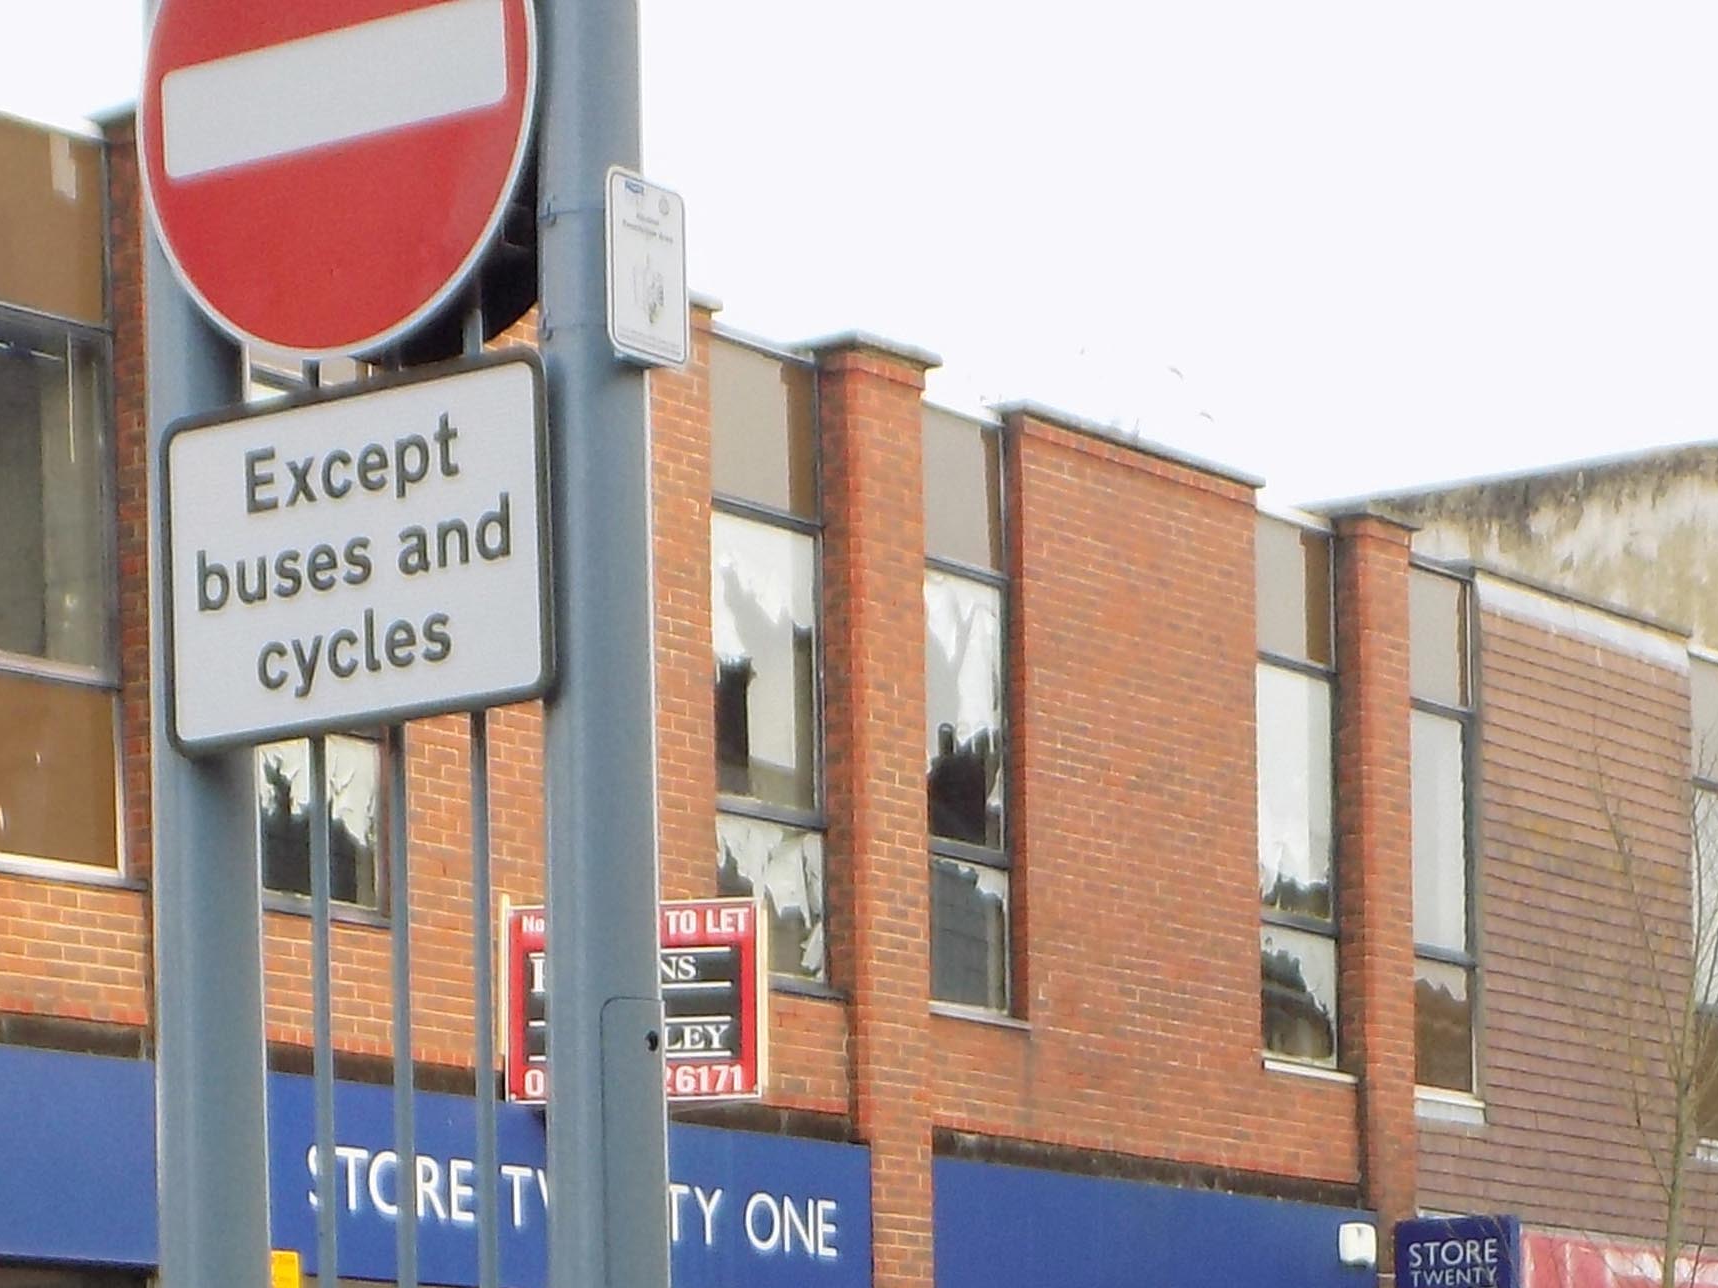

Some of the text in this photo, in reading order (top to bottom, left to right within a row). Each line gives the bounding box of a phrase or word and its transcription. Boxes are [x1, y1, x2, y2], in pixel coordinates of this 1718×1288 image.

[244, 411, 460, 514] Except
[196, 491, 511, 612] buses and
[257, 607, 453, 698] cycles
[665, 909, 697, 935] TO
[706, 907, 750, 934] LET
[500, 1164, 724, 1246] TTY
[744, 1192, 839, 1257] ONE
[1408, 1238, 1499, 1268] STORE
[1410, 1265, 1498, 1288] TWENTY
